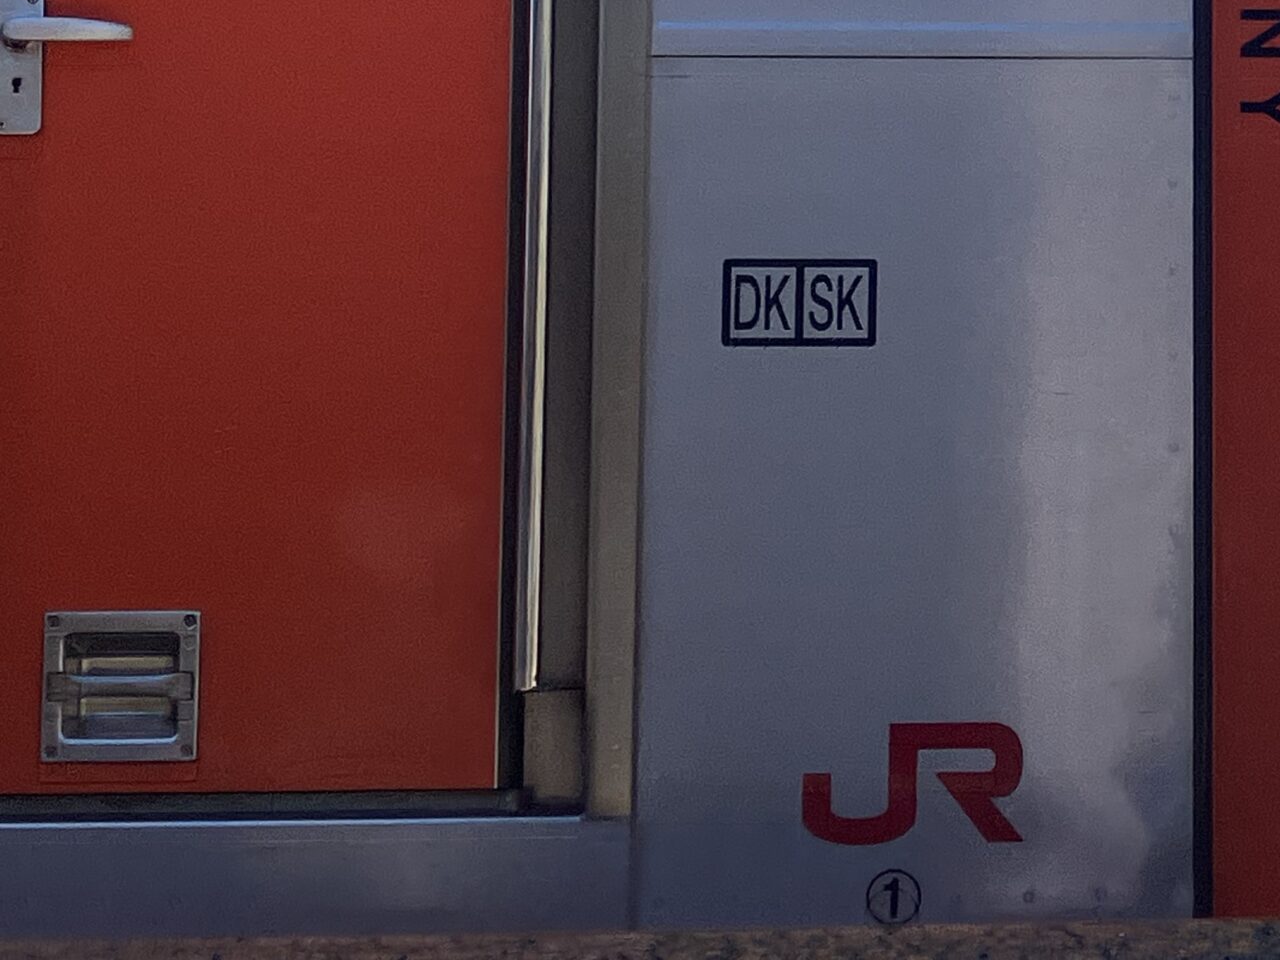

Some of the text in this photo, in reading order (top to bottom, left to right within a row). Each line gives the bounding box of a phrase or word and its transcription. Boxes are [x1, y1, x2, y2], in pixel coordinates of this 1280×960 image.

[733, 273, 865, 332] DK SK
[802, 721, 1025, 846] JR
